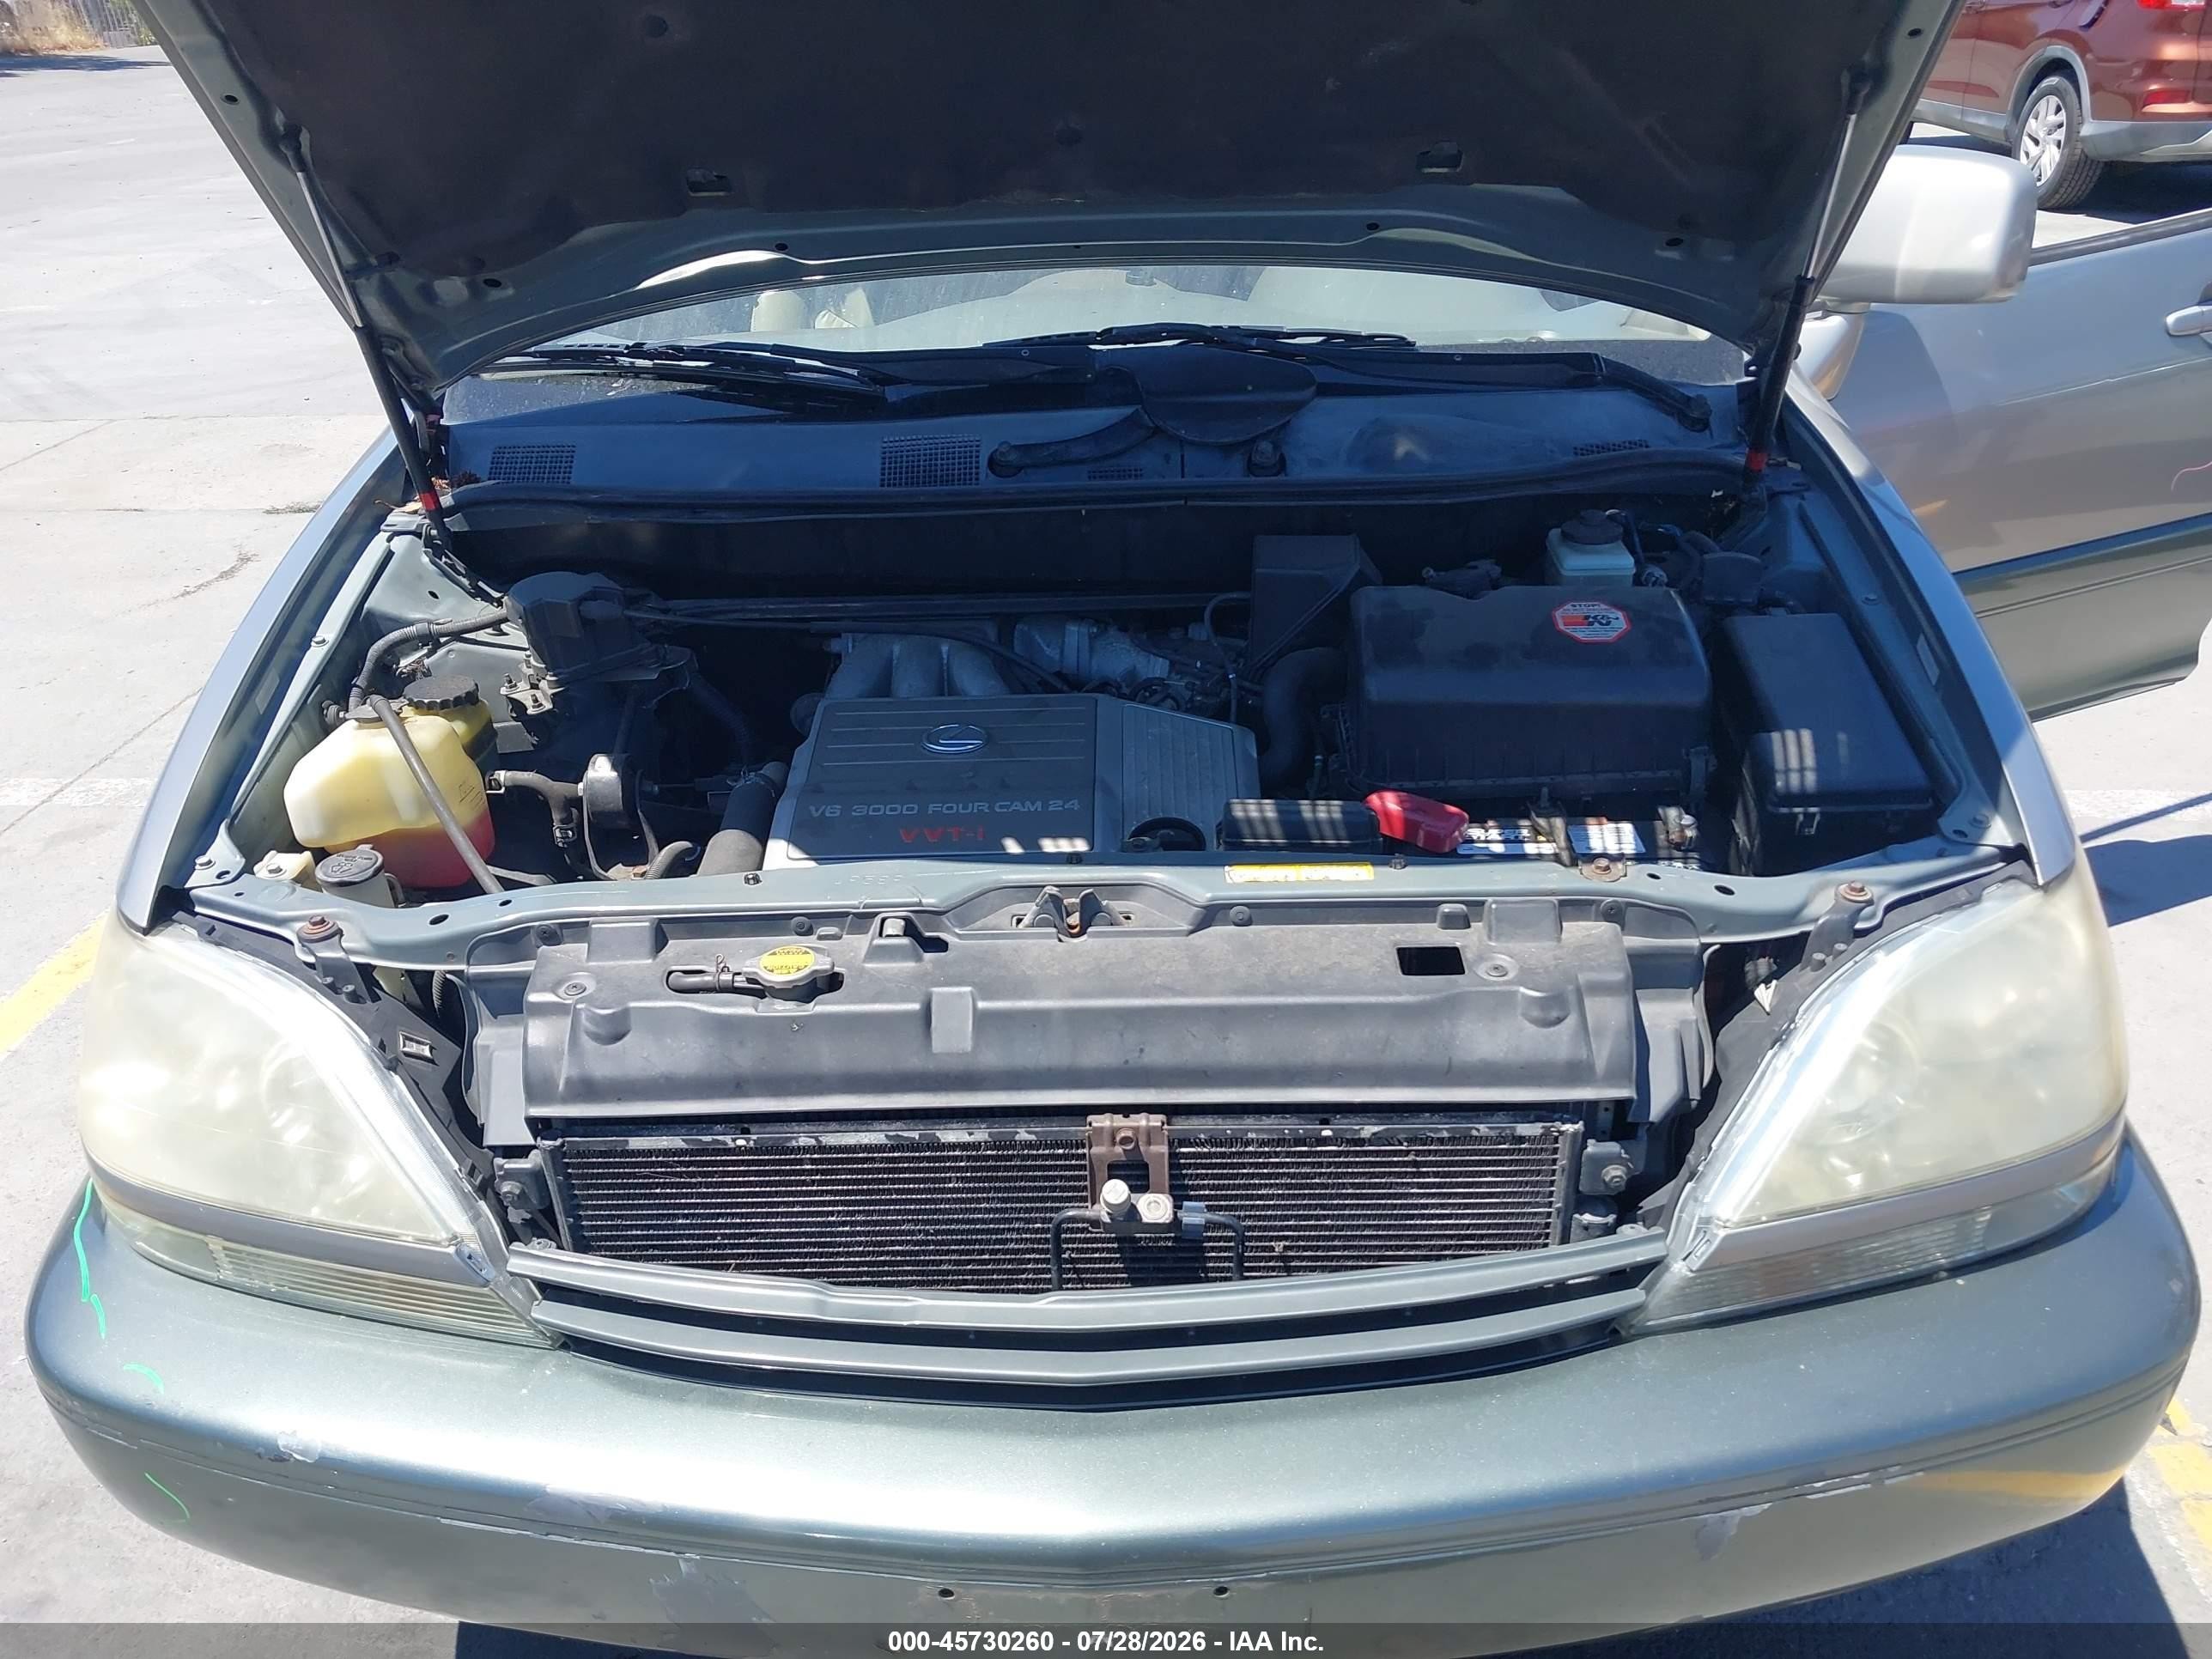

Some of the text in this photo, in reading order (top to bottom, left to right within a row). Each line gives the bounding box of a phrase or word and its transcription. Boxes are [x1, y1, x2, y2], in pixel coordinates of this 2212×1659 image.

[809, 799, 1080, 817] V6 3000 FOUR CAM 24
